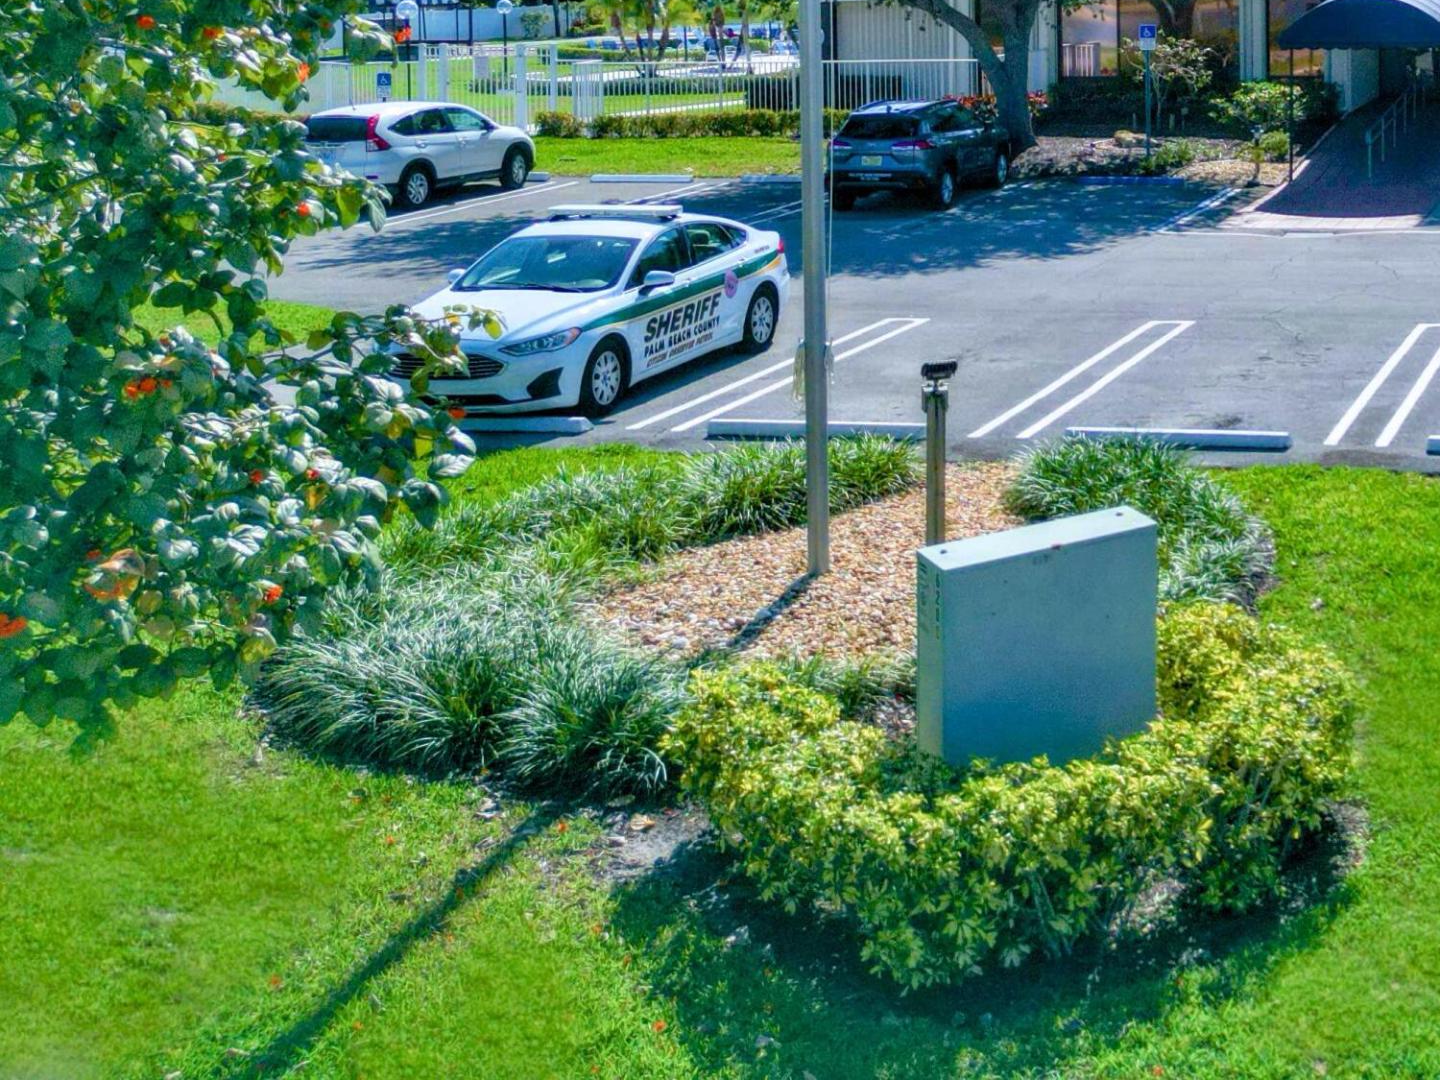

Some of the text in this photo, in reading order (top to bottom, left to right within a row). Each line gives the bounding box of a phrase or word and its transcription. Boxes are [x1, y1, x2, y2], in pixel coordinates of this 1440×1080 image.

[644, 292, 721, 342] SHERIFF
[644, 339, 665, 357] PALM
[668, 327, 692, 347] BEACH
[693, 315, 720, 336] COUNTY
